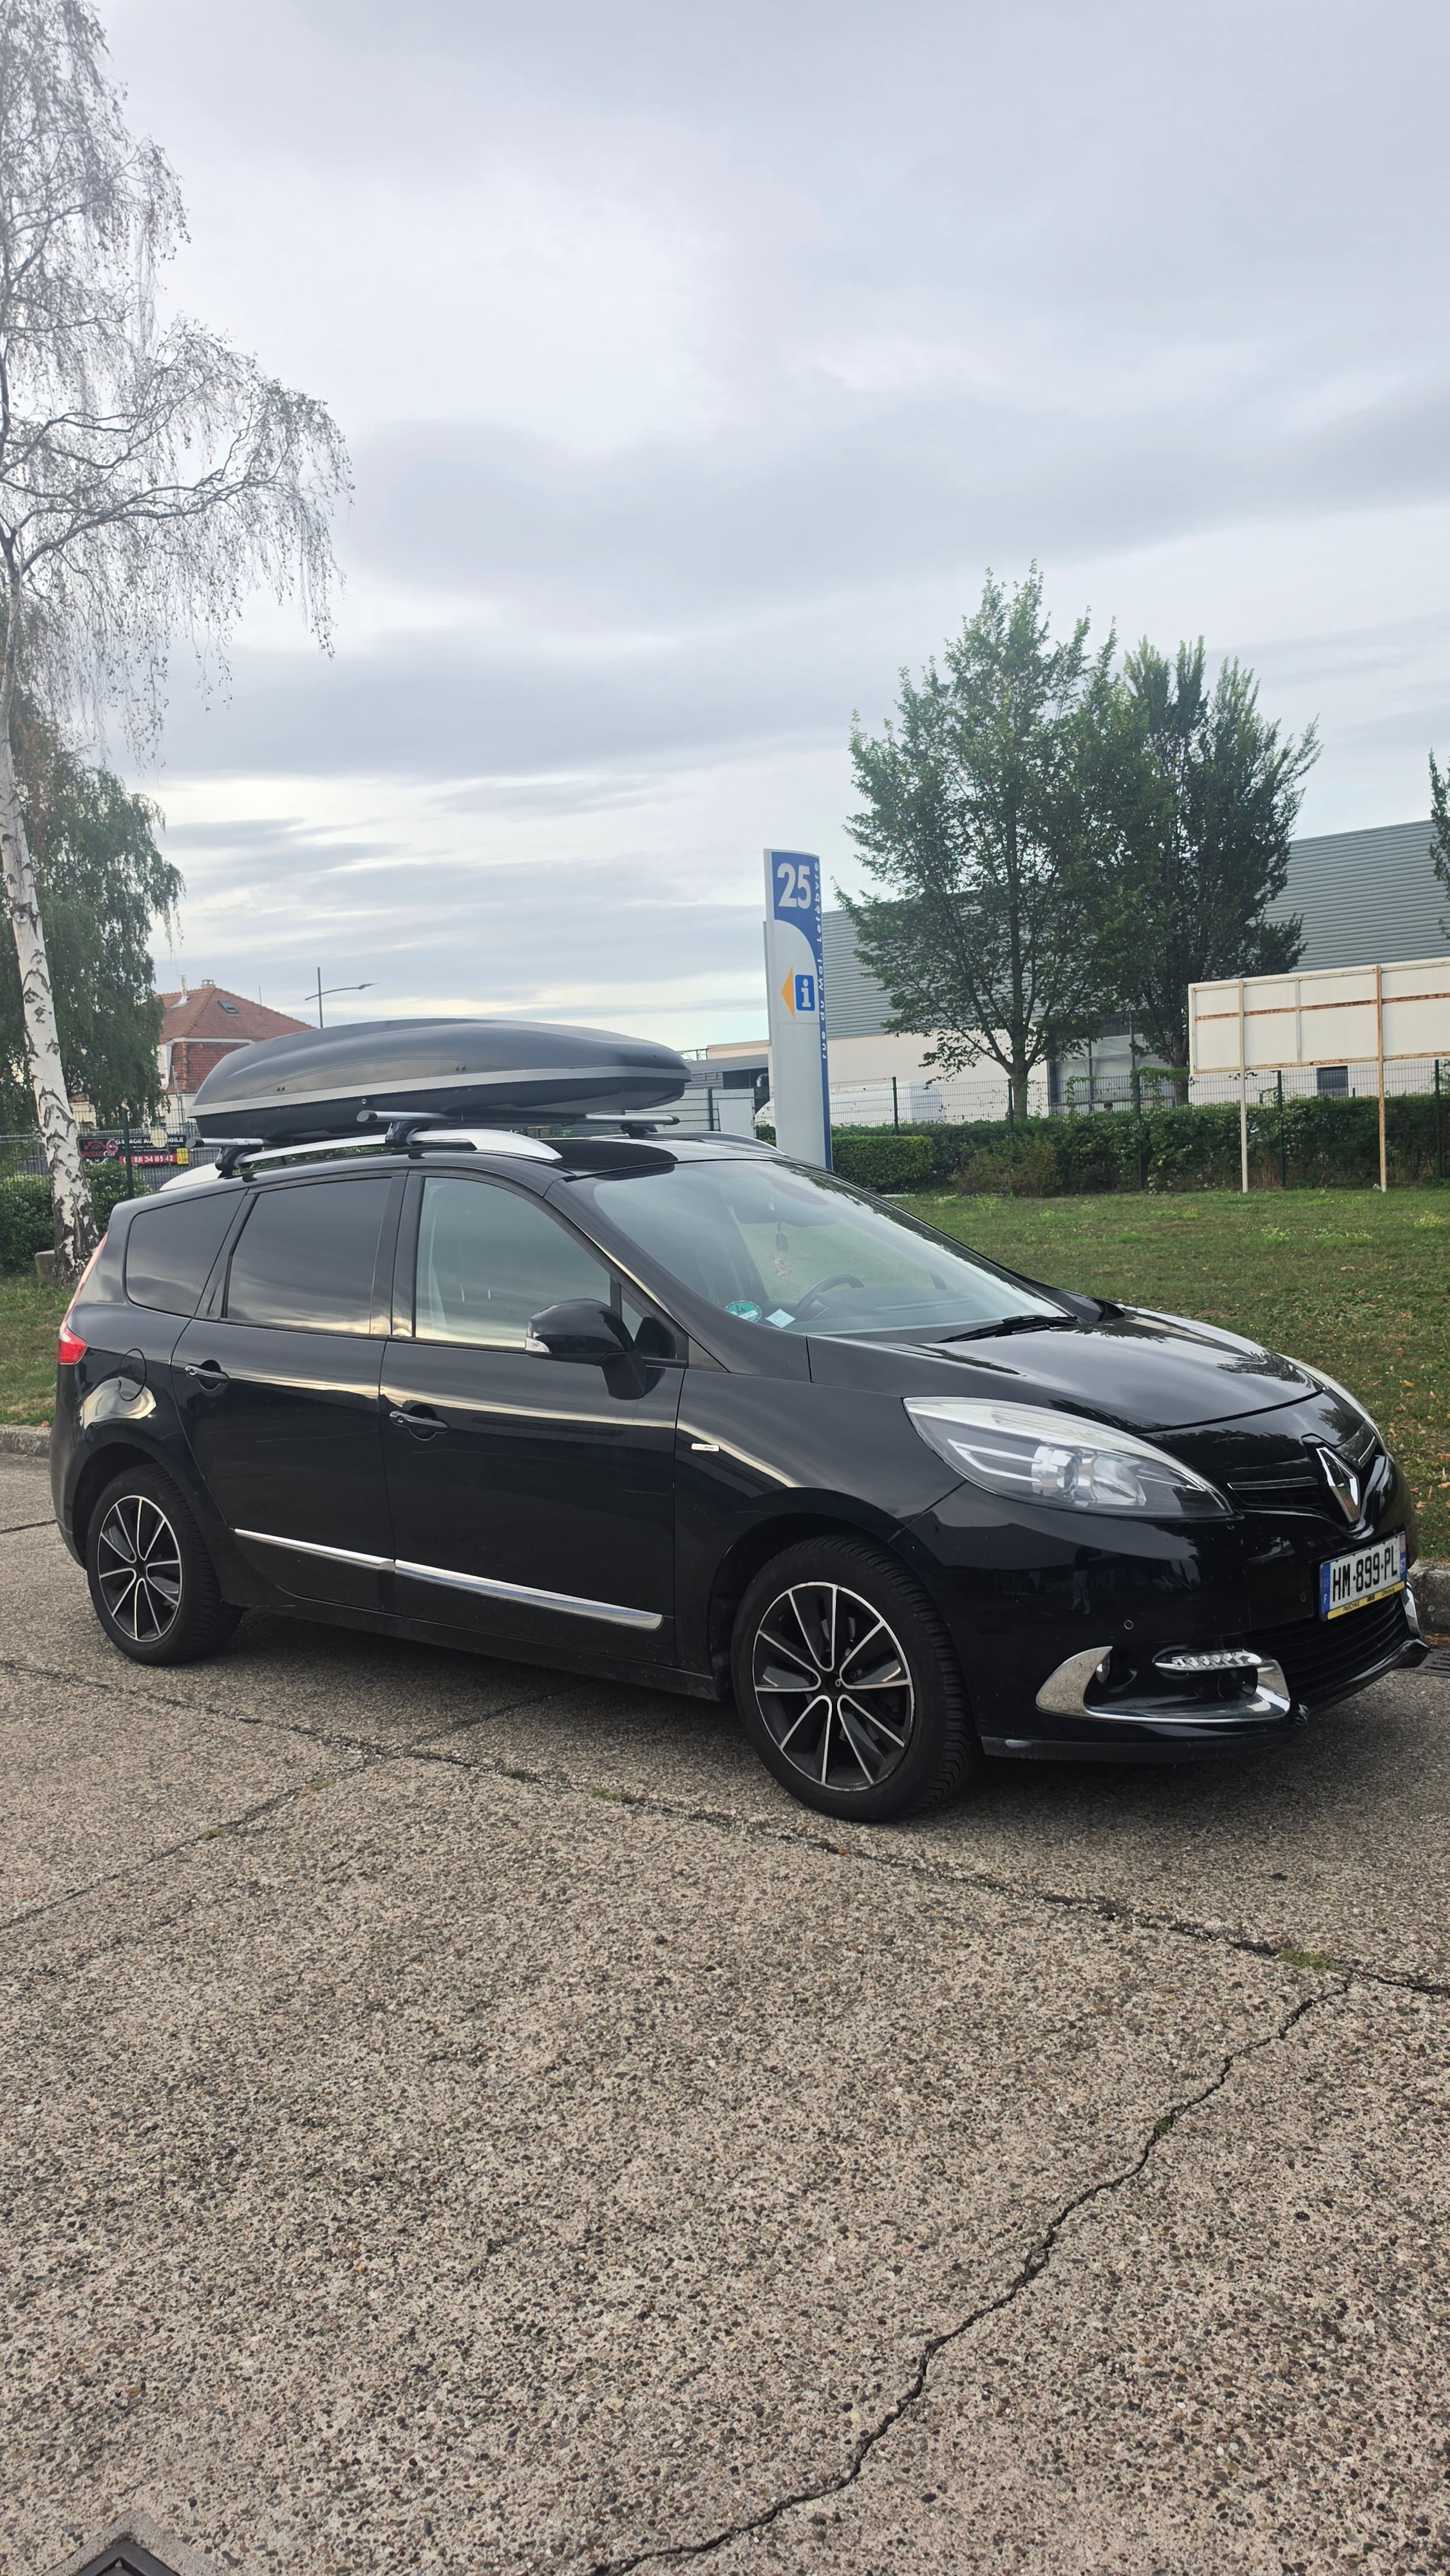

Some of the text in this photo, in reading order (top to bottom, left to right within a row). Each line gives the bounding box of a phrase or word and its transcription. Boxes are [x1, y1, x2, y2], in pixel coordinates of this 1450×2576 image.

[777, 862, 811, 909] 25
[801, 978, 811, 1008] i
[820, 1001, 825, 1021] du
[1332, 1545, 1397, 1602] HM-899-PL
